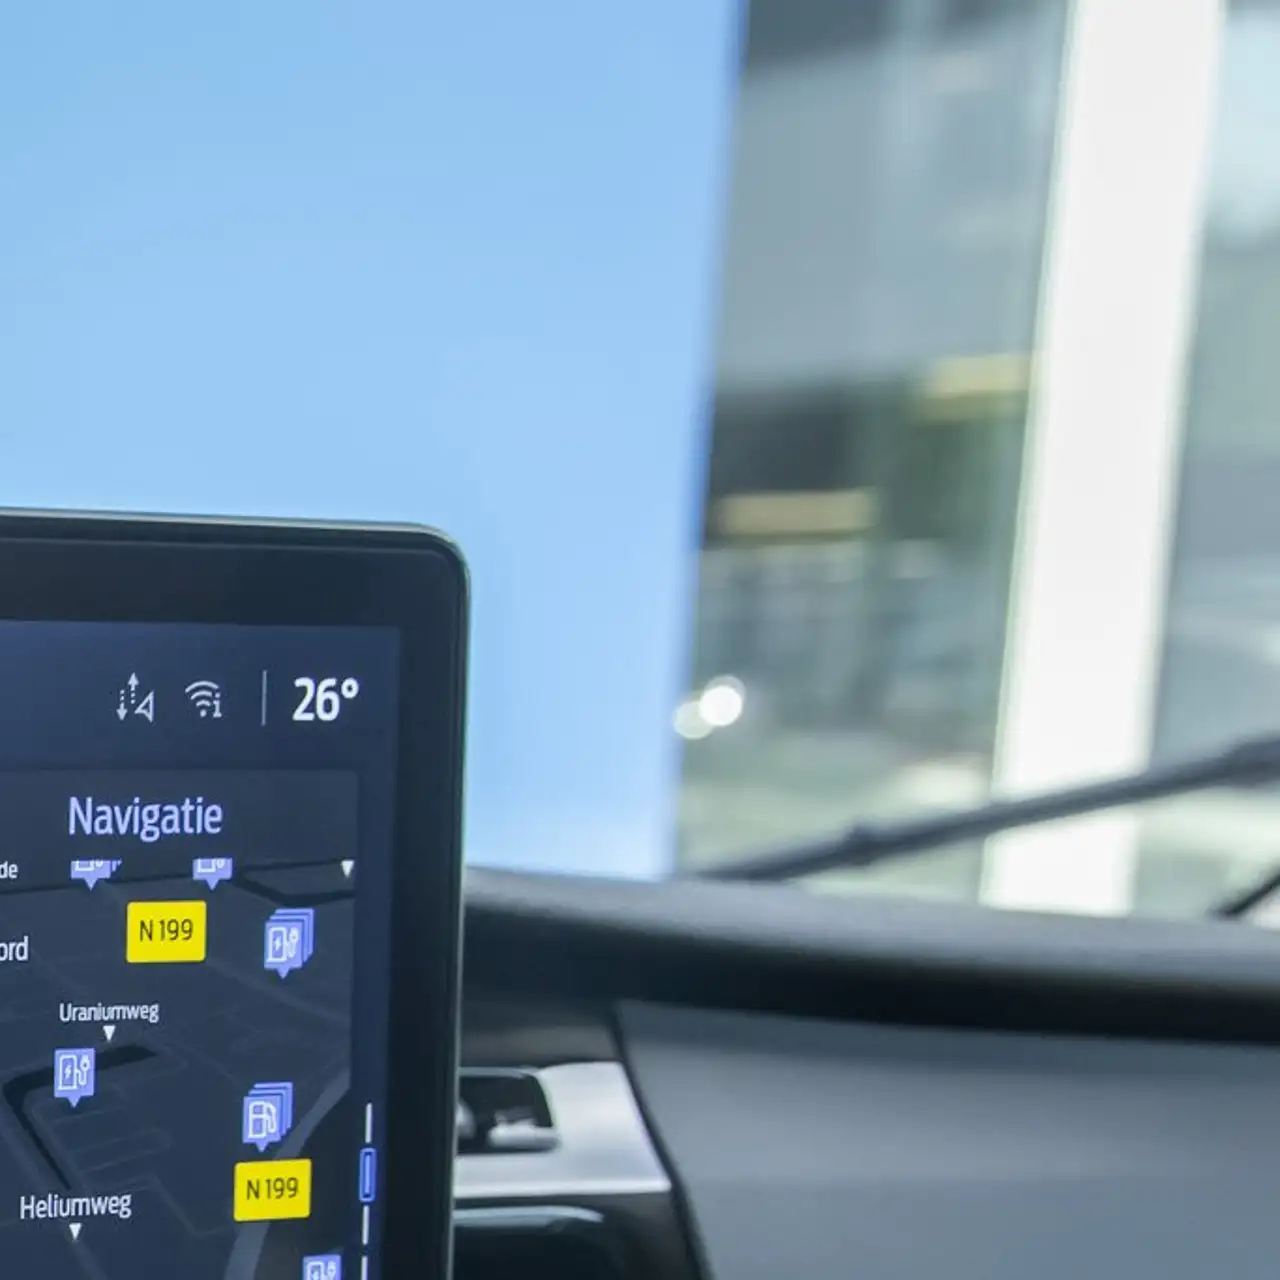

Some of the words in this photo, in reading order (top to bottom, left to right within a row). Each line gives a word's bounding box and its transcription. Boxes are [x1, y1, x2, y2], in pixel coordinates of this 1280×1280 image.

[292, 676, 360, 721] 26°
[68, 796, 223, 843] Navigatie
[139, 919, 154, 942] N
[159, 918, 194, 941] 199
[59, 1002, 160, 1024] Uraniumweg
[245, 1178, 261, 1201] N
[265, 1176, 299, 1200] 199
[20, 1193, 132, 1220] Heliumweg
